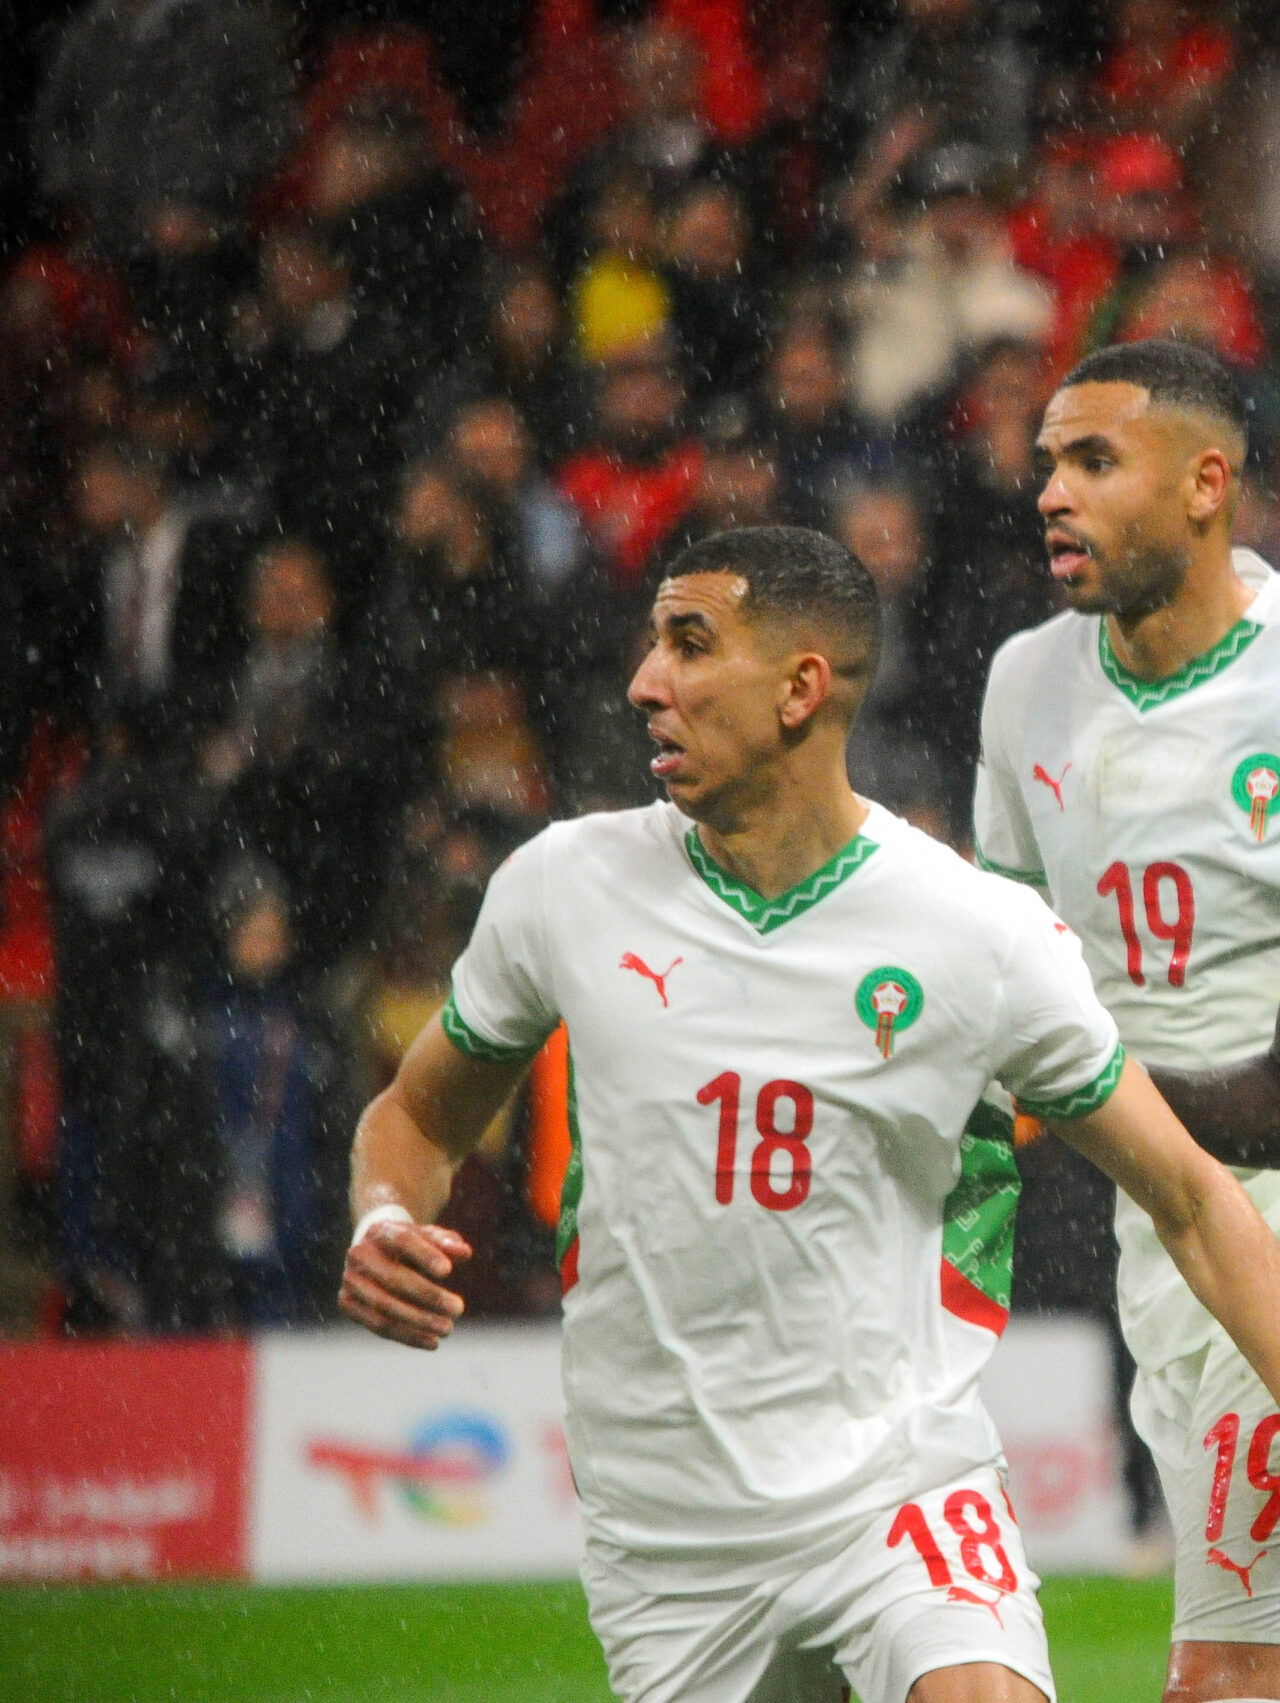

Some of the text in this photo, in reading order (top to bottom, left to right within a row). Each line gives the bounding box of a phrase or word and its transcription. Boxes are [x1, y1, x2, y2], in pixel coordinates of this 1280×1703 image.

[1097, 861, 1195, 987] 19
[696, 1071, 814, 1212] 18
[886, 1489, 1018, 1593] 18
